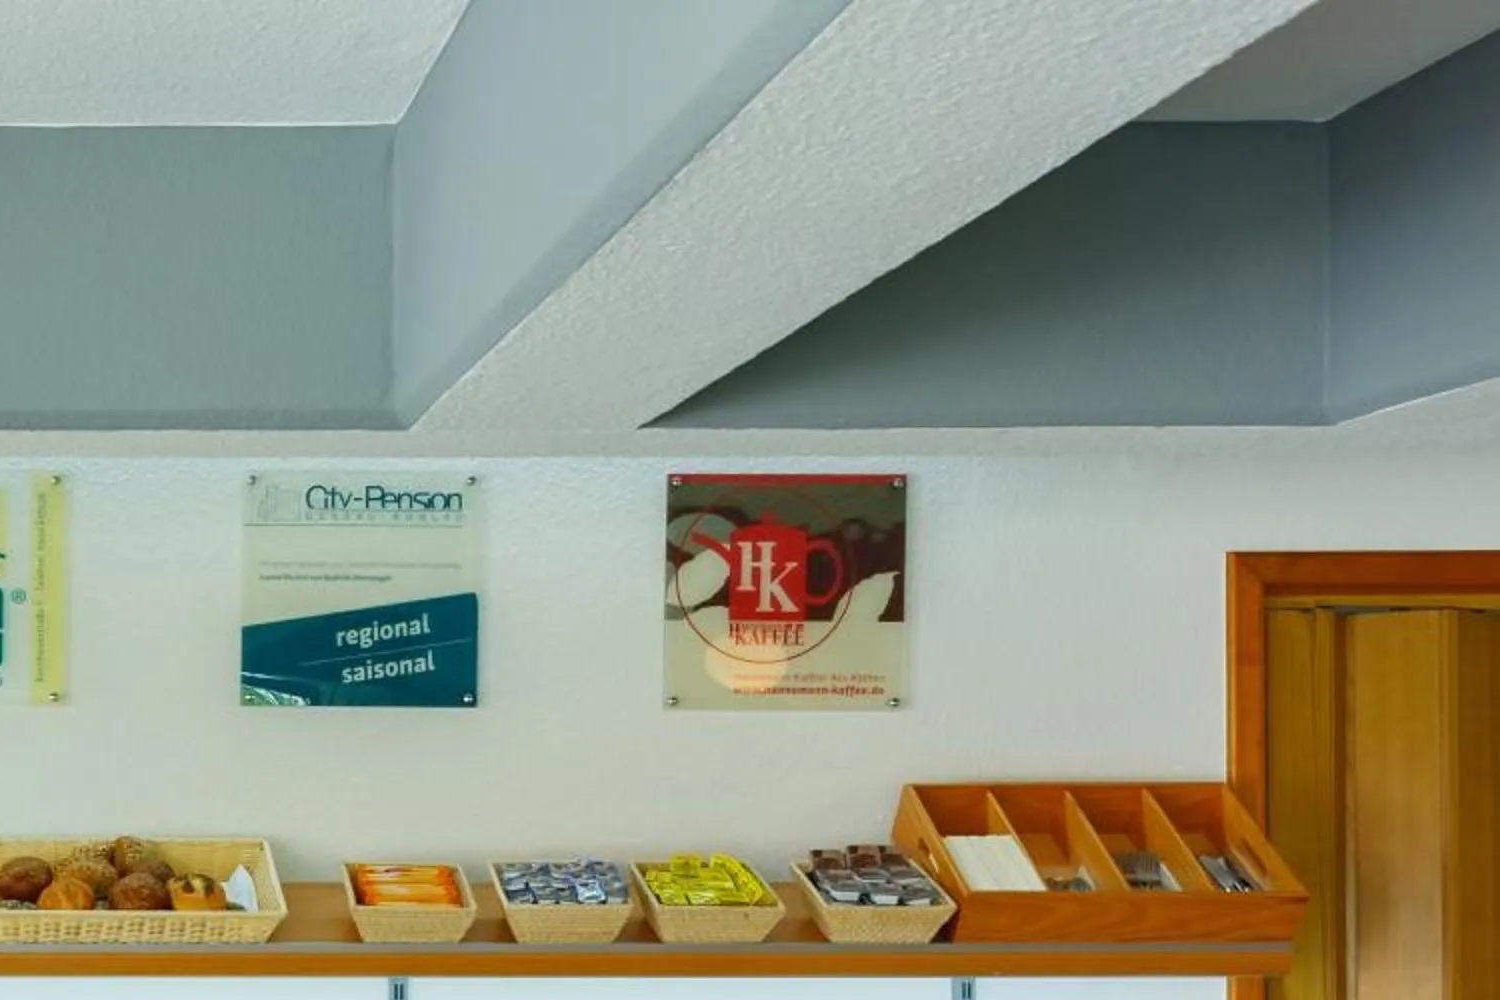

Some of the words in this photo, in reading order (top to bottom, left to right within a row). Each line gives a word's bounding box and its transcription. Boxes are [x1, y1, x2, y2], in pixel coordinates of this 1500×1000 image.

[736, 541, 799, 613] HK
[335, 613, 431, 649] regional
[735, 624, 805, 646] KAFFEE
[341, 650, 435, 684] saisonal
